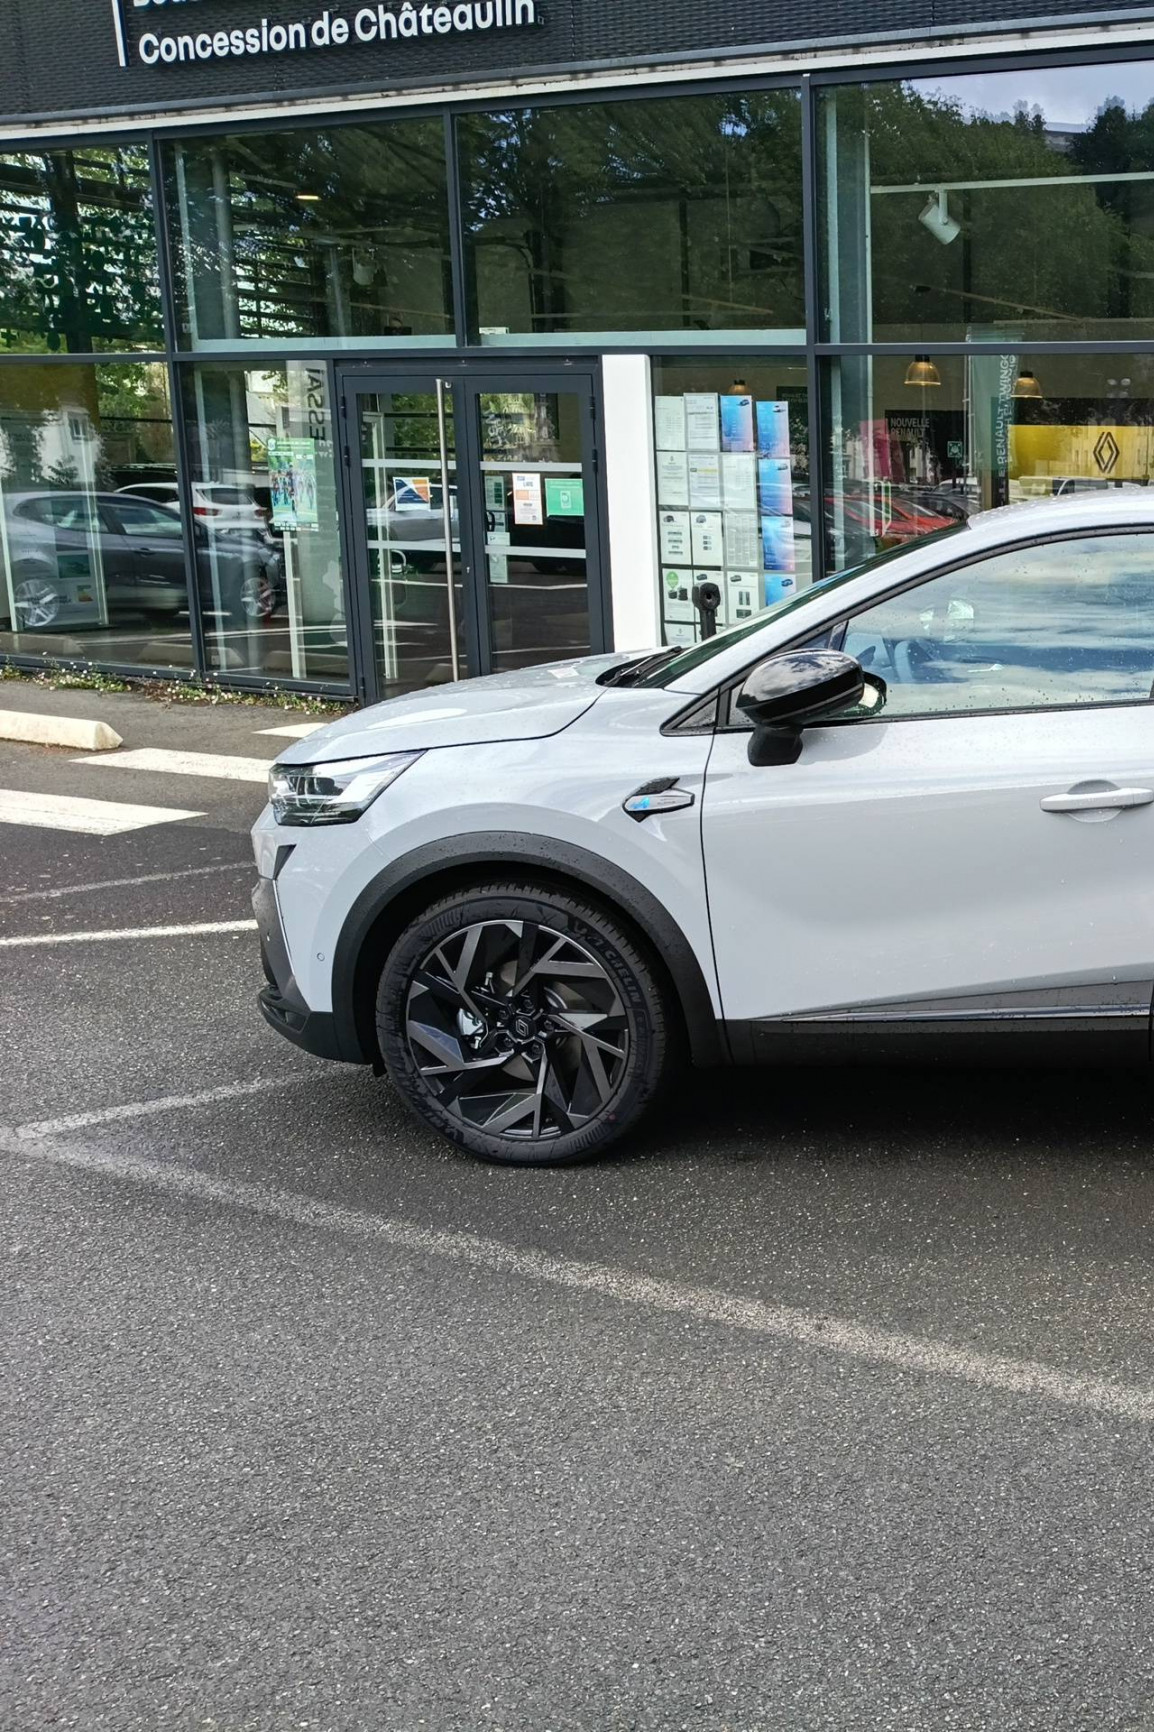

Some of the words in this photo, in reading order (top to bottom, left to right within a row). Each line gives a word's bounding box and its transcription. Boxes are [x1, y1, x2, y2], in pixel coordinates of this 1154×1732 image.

[139, 18, 306, 65] Concession
[311, 11, 350, 46] de
[354, 0, 536, 42] Châteaulin
[890, 417, 930, 428] NOUVELLE
[995, 407, 1007, 465] RENAULT
